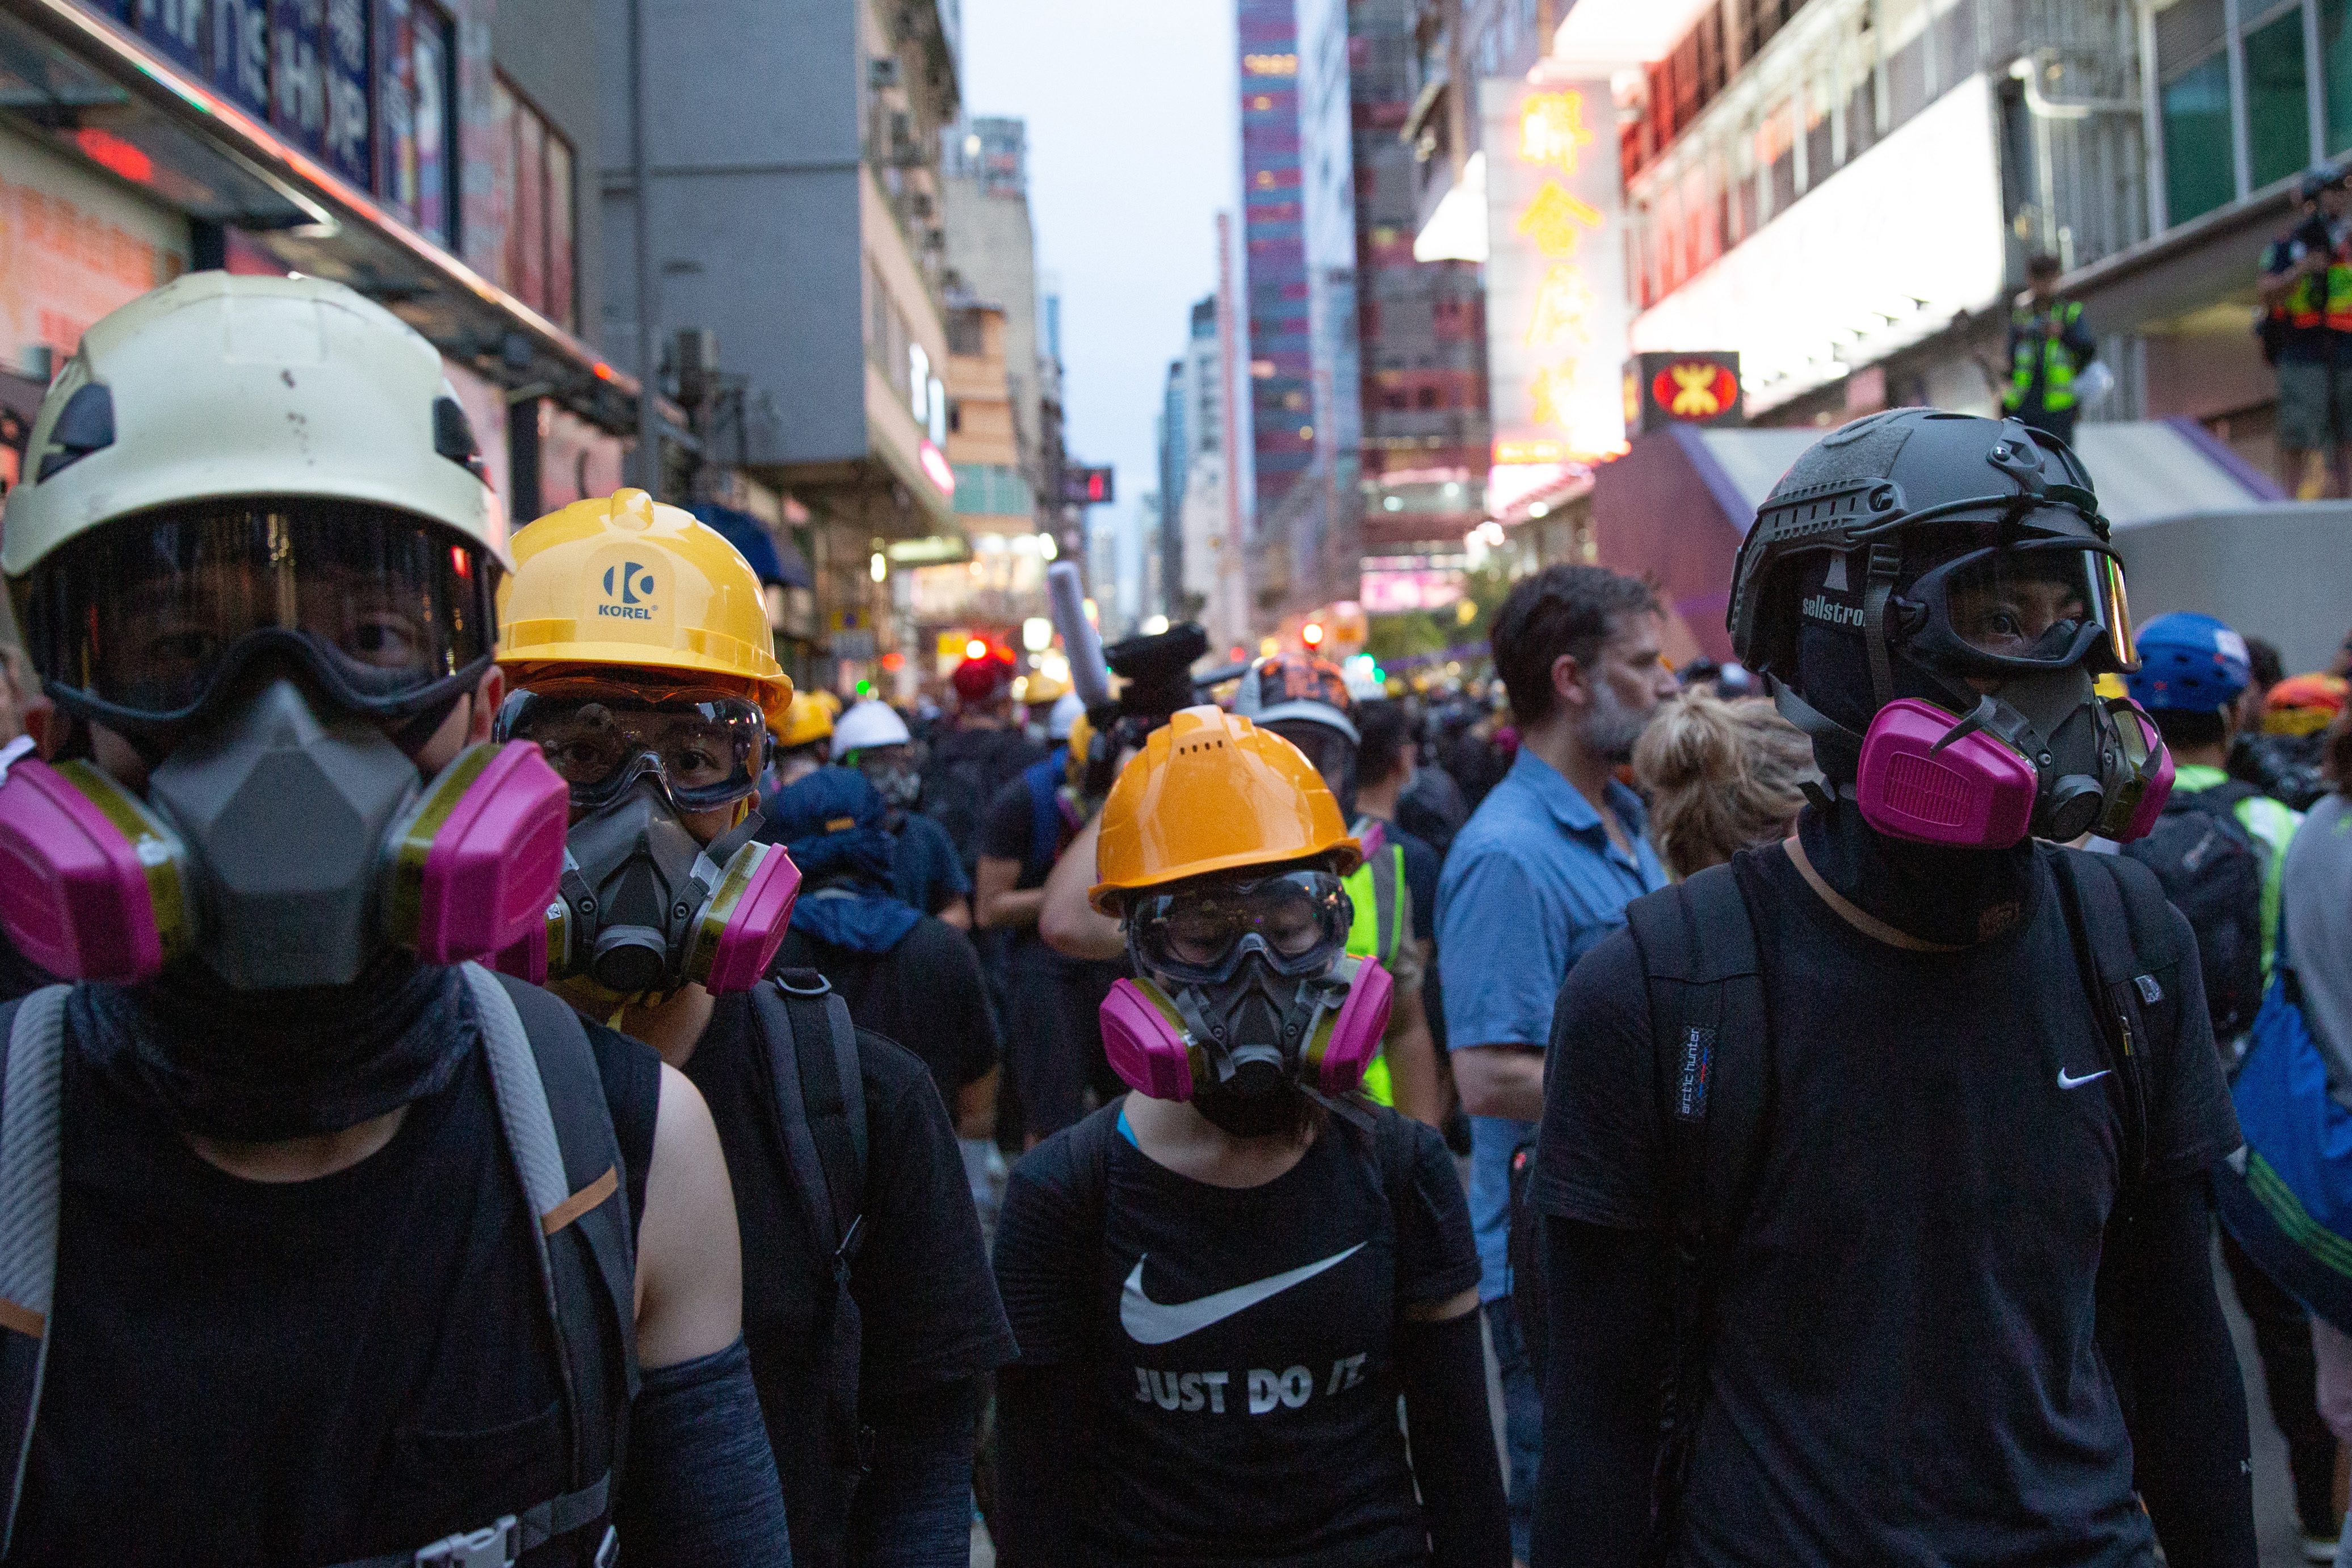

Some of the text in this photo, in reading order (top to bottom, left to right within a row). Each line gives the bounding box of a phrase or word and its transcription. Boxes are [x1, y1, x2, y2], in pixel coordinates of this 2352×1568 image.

[598, 604, 652, 620] KOREL
[1803, 595, 1866, 627] sellstro
[1682, 1028, 1700, 1115] arctic hunter
[1135, 1367, 1229, 1414] JUST
[1248, 1365, 1313, 1415] DO
